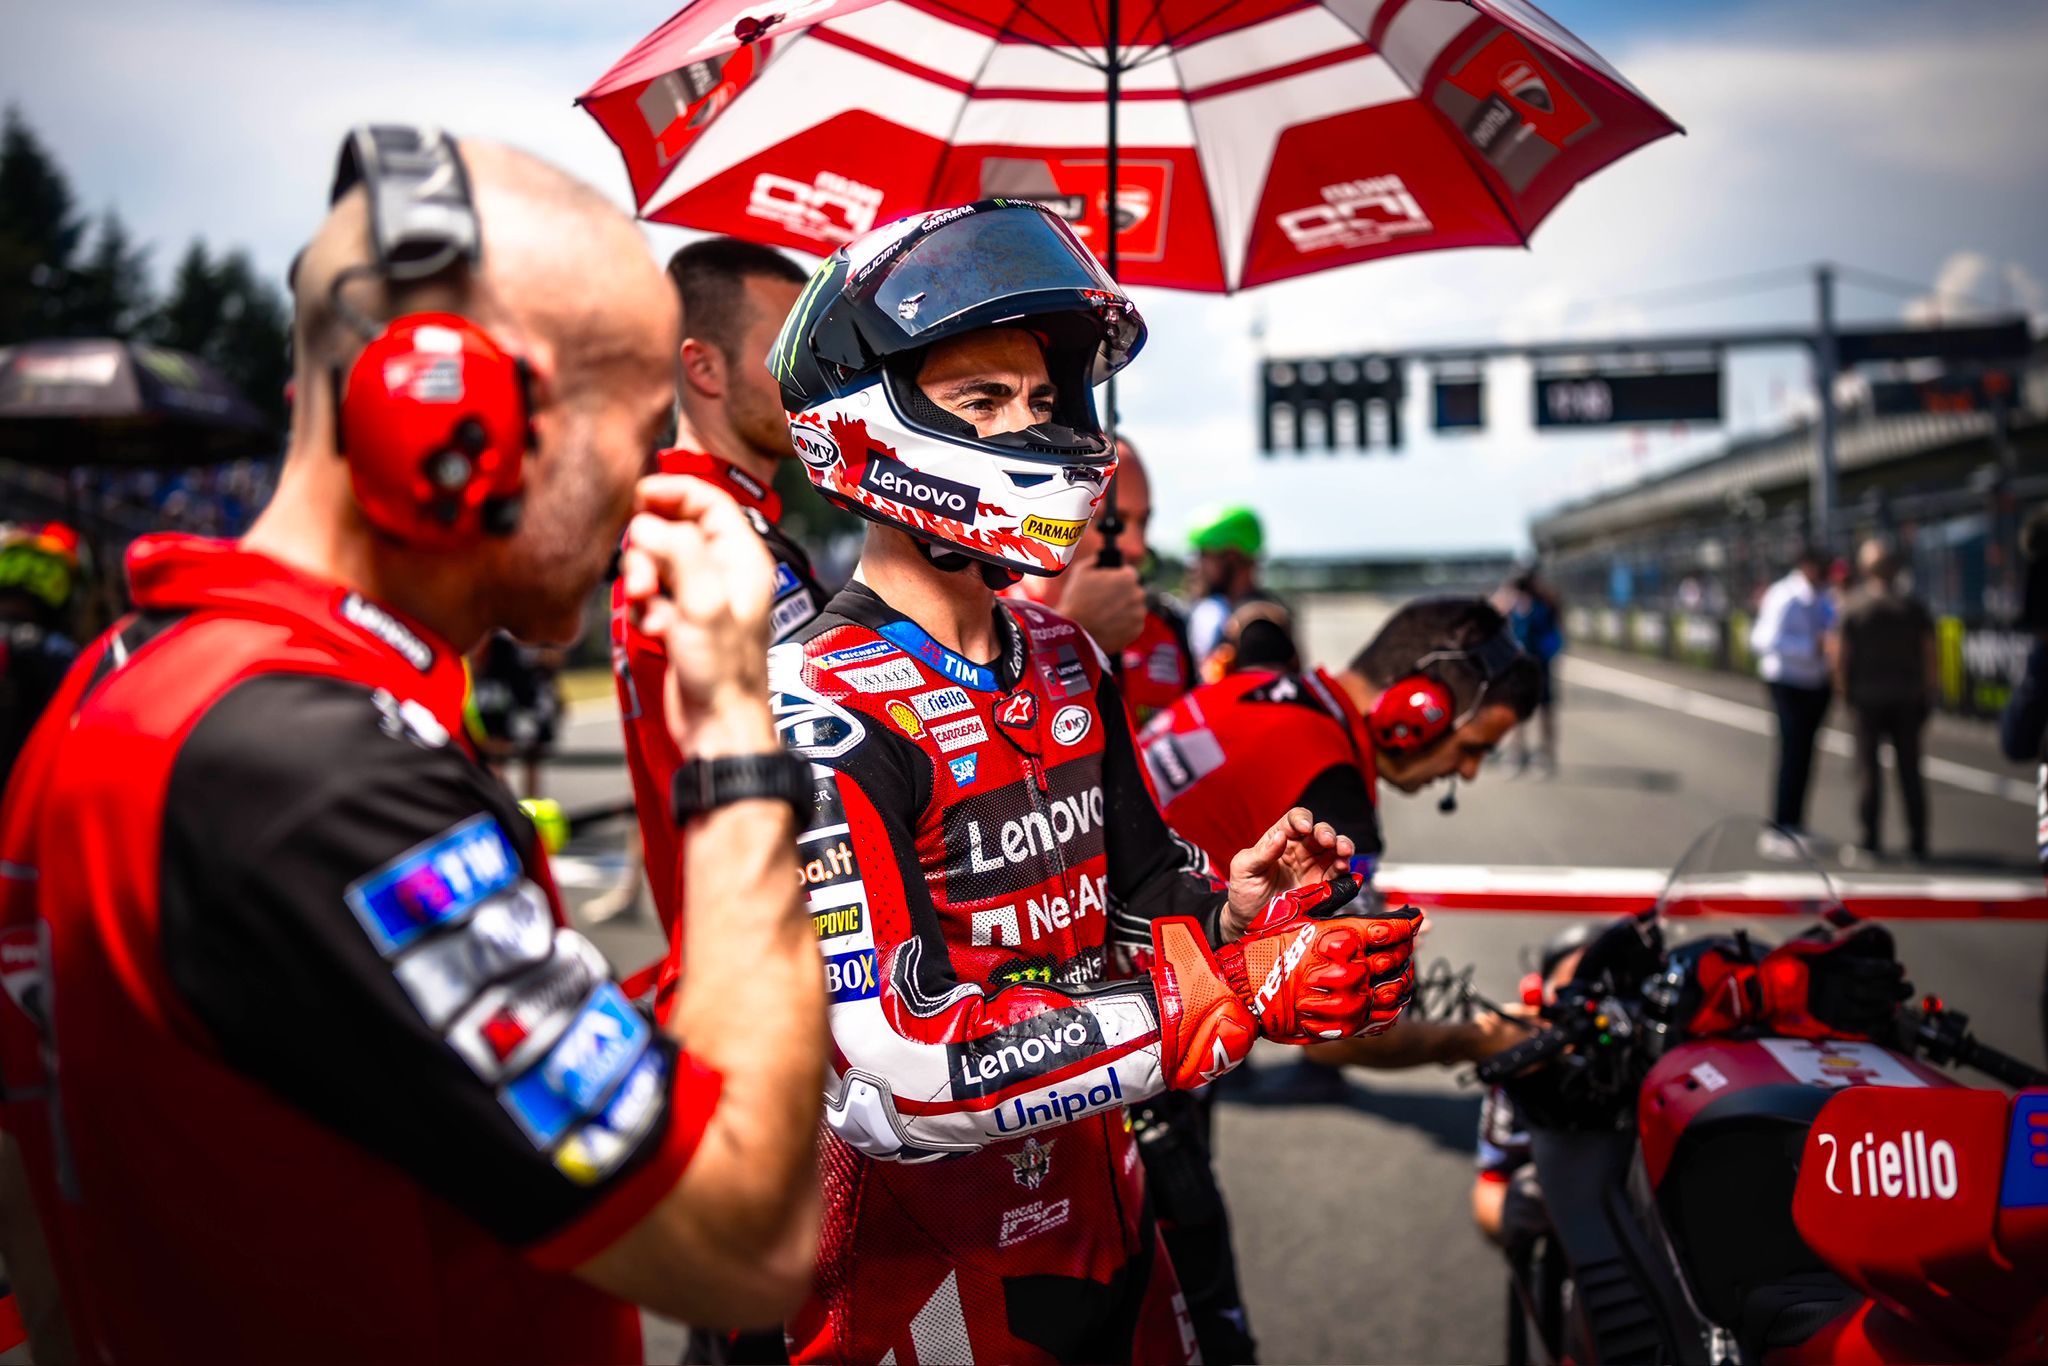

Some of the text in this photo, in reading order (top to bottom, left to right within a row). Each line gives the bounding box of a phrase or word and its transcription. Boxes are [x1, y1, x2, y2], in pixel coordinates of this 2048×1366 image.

[921, 205, 975, 231] CARRERA
[858, 239, 903, 282] SUOMY
[868, 459, 967, 512] Lenovo
[840, 643, 889, 660] MICHELIN
[943, 654, 979, 686] TIM
[928, 689, 968, 712] riello
[935, 722, 982, 743] CARRERA
[951, 759, 976, 783] SAP
[967, 786, 1104, 874] Lenovo
[960, 1022, 1087, 1086] Lenovo
[994, 1066, 1123, 1133] Unipol
[1850, 1130, 1958, 1200] riello
